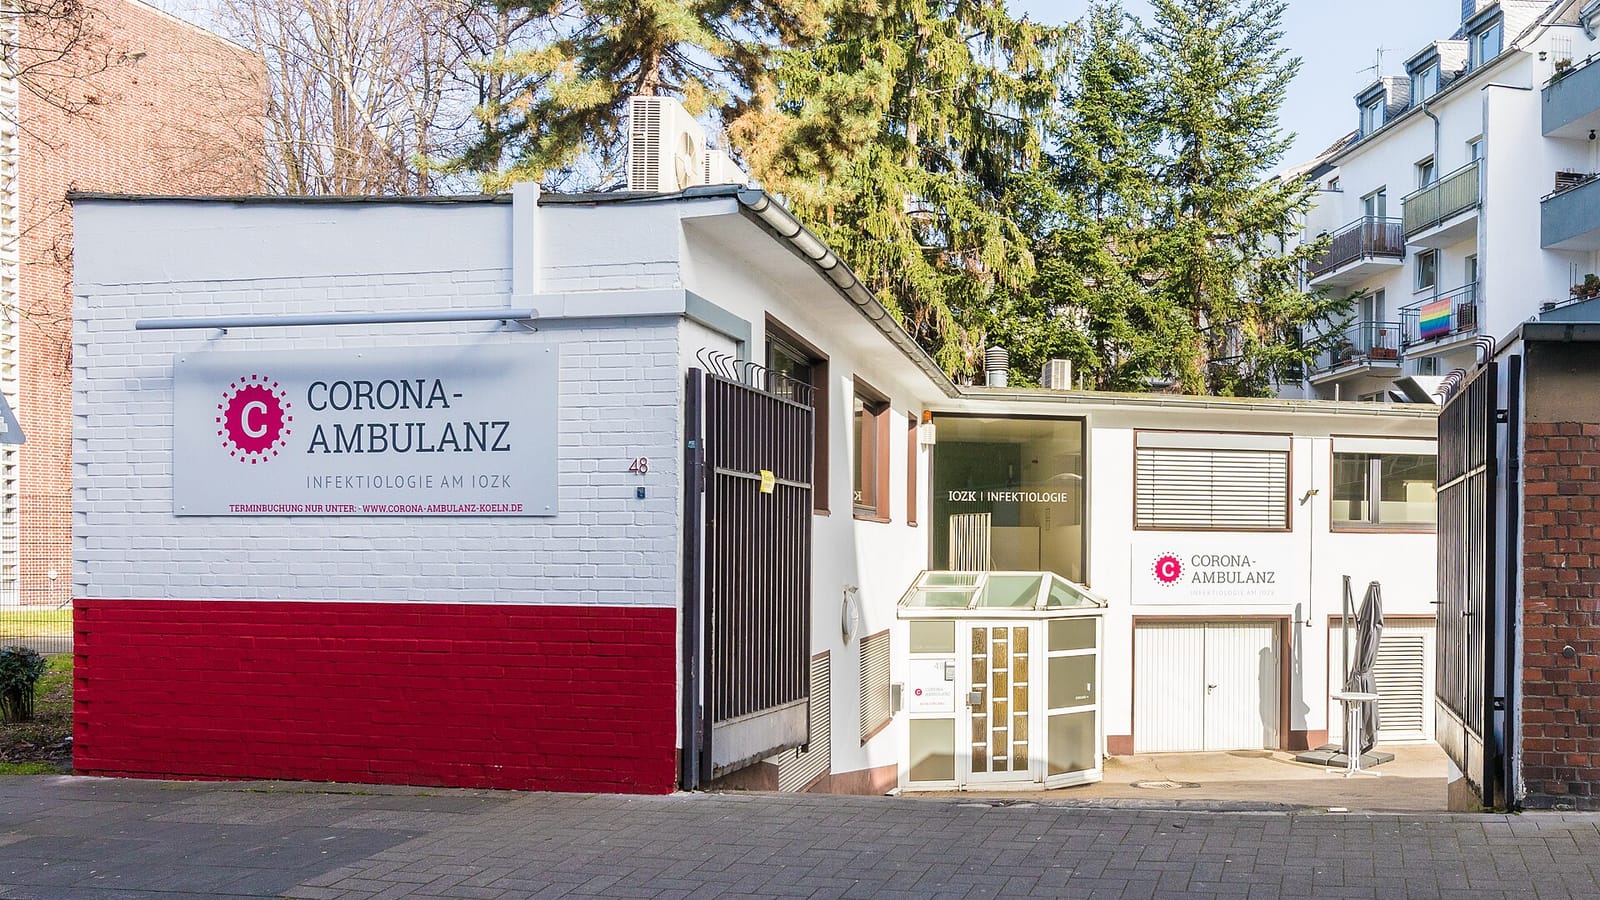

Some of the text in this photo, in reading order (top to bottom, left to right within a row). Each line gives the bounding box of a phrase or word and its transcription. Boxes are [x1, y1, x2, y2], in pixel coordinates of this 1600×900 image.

[307, 379, 463, 411] CORONA-
[241, 400, 268, 438] C
[307, 421, 511, 454] AMBULANZ
[628, 457, 648, 475] 48
[306, 475, 511, 489] INFEKTIOLOGIE AM IOZK
[949, 491, 976, 502] IOZK
[988, 491, 1067, 503] INFEKTIOLOGIE
[229, 503, 523, 513] TERMINBUCHUNG NUR UNTER: WWW.CORONA-AMBULANZ-KOELN.DE
[1191, 554, 1256, 567] CORONA-
[1161, 561, 1175, 577] C
[1191, 571, 1275, 584] AMBULANZ
